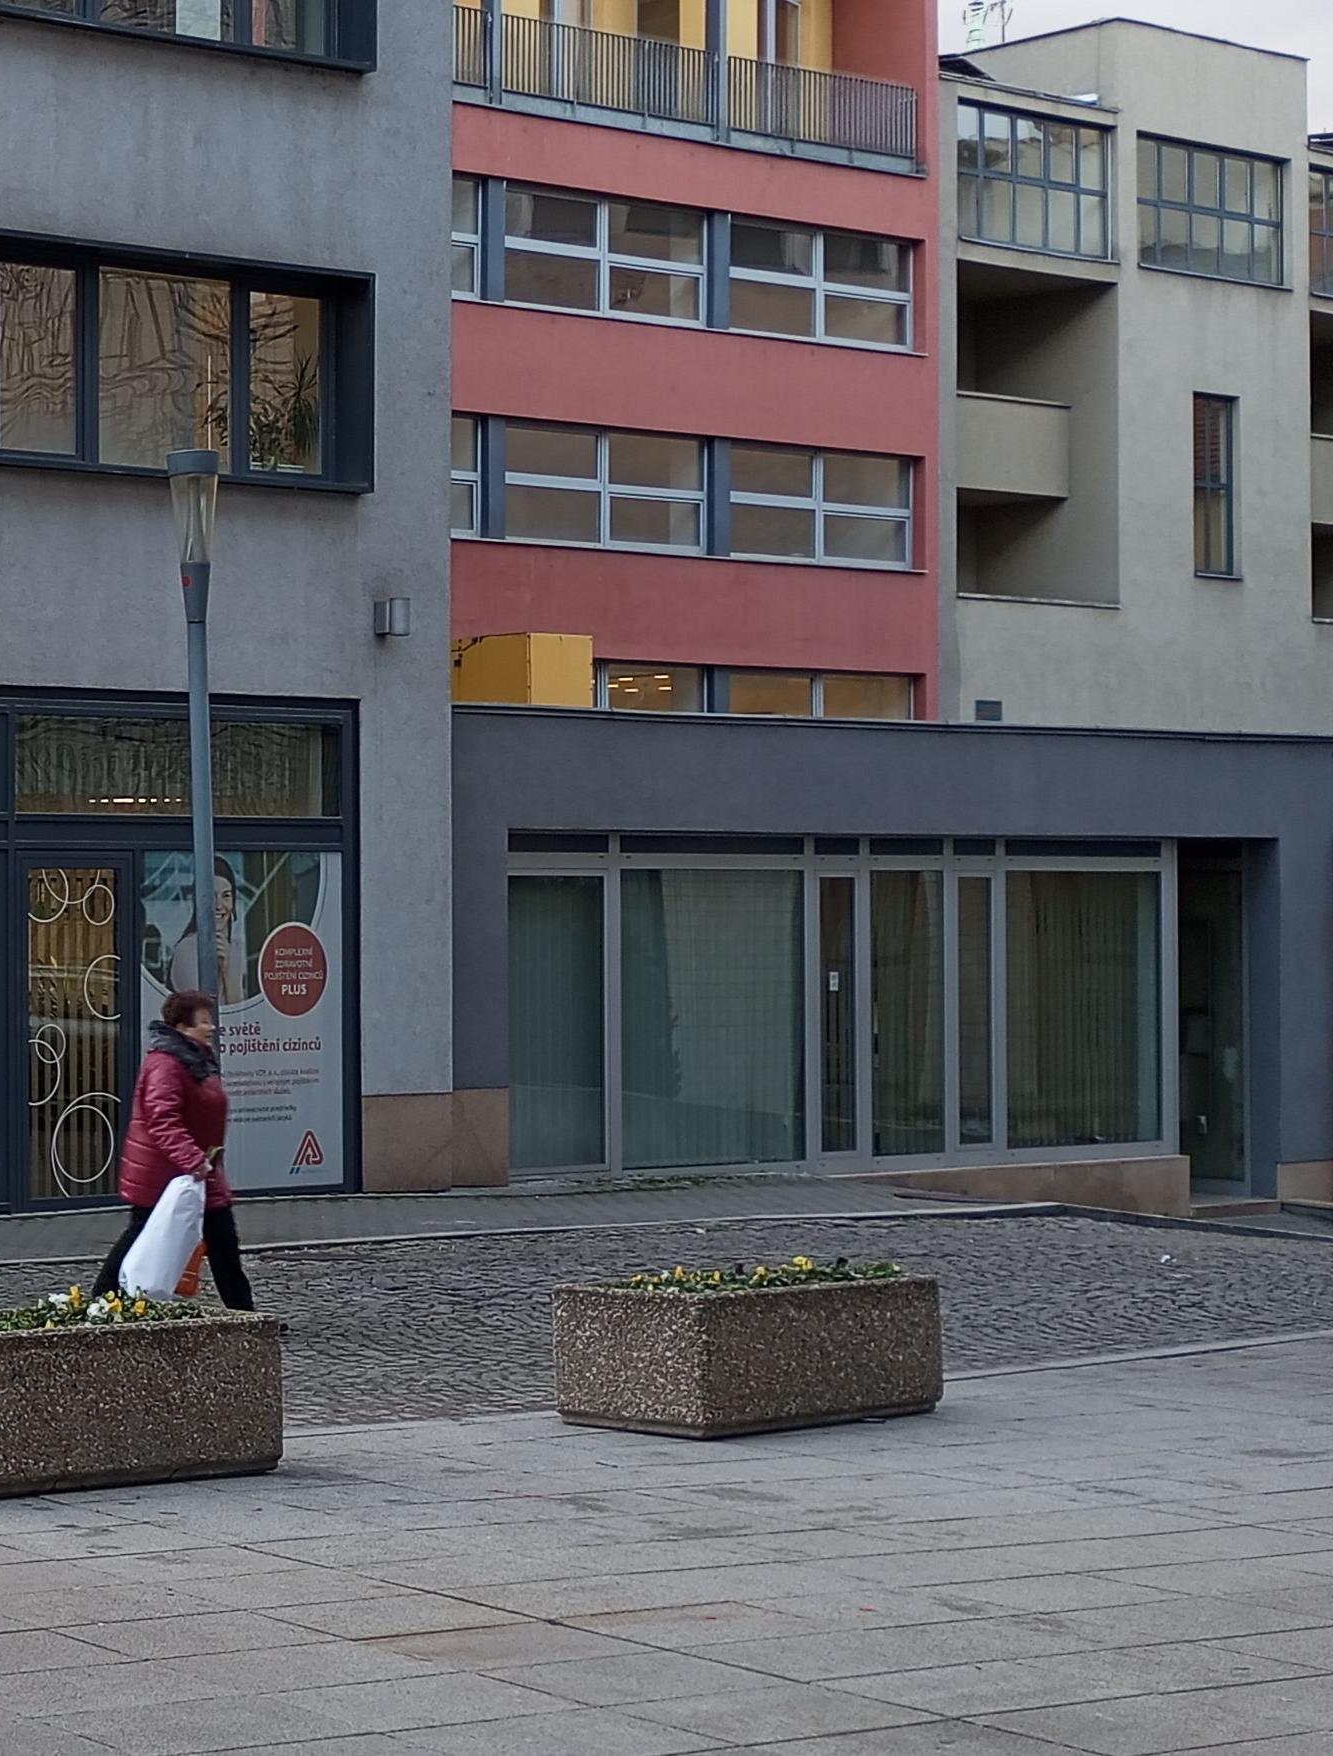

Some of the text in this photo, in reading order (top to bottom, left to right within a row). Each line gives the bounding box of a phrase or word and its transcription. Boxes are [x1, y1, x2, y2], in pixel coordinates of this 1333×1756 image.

[275, 947, 313, 956] KOMPLEXNÍ
[275, 958, 313, 968] ZDRAVOTNÍ
[281, 984, 307, 995] PLUS
[228, 1021, 261, 1036] světě
[229, 1038, 280, 1055] pojištění
[282, 1036, 321, 1052] cizinců
